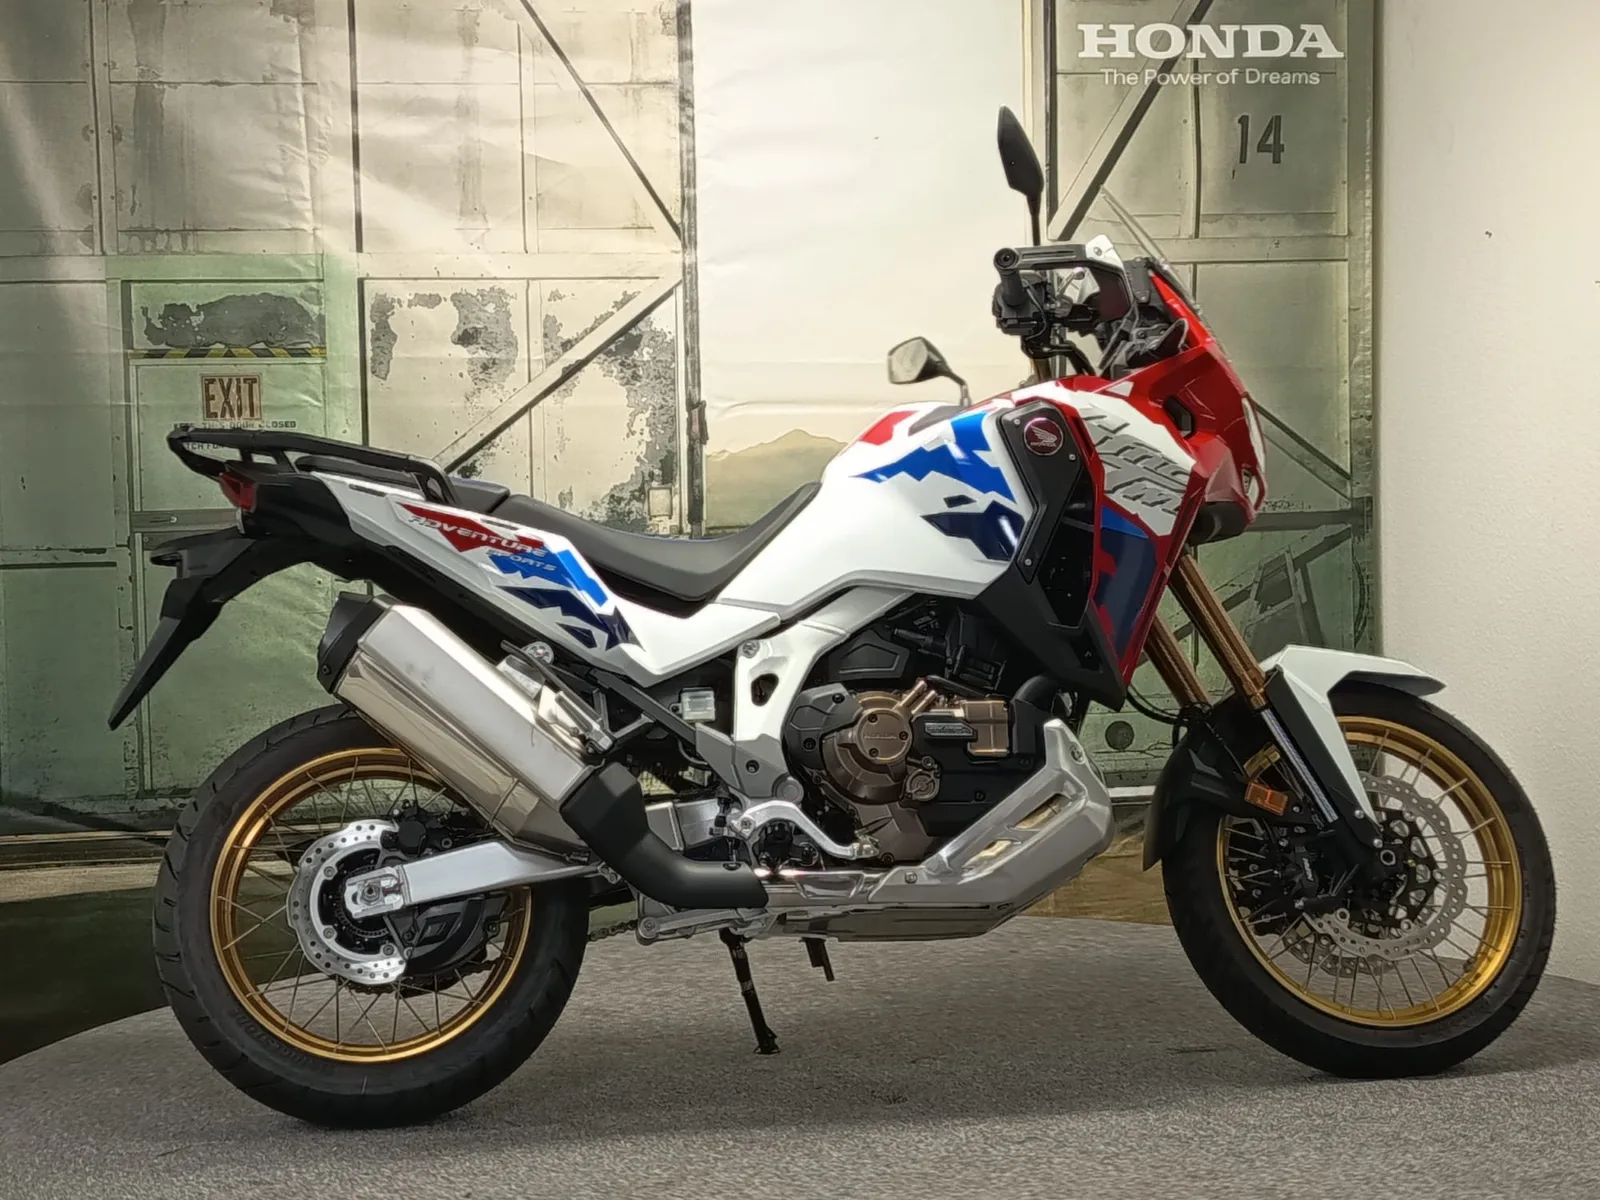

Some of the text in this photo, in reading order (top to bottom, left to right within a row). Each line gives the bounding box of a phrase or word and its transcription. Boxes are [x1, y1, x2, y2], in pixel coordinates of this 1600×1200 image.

[1077, 23, 1344, 59] HONDA
[1100, 67, 1320, 86] The Power of Dreams
[1237, 114, 1285, 165] 14
[204, 378, 257, 418] EXIT
[407, 515, 548, 558] ADVENTURE
[486, 548, 557, 572] SPORTS
